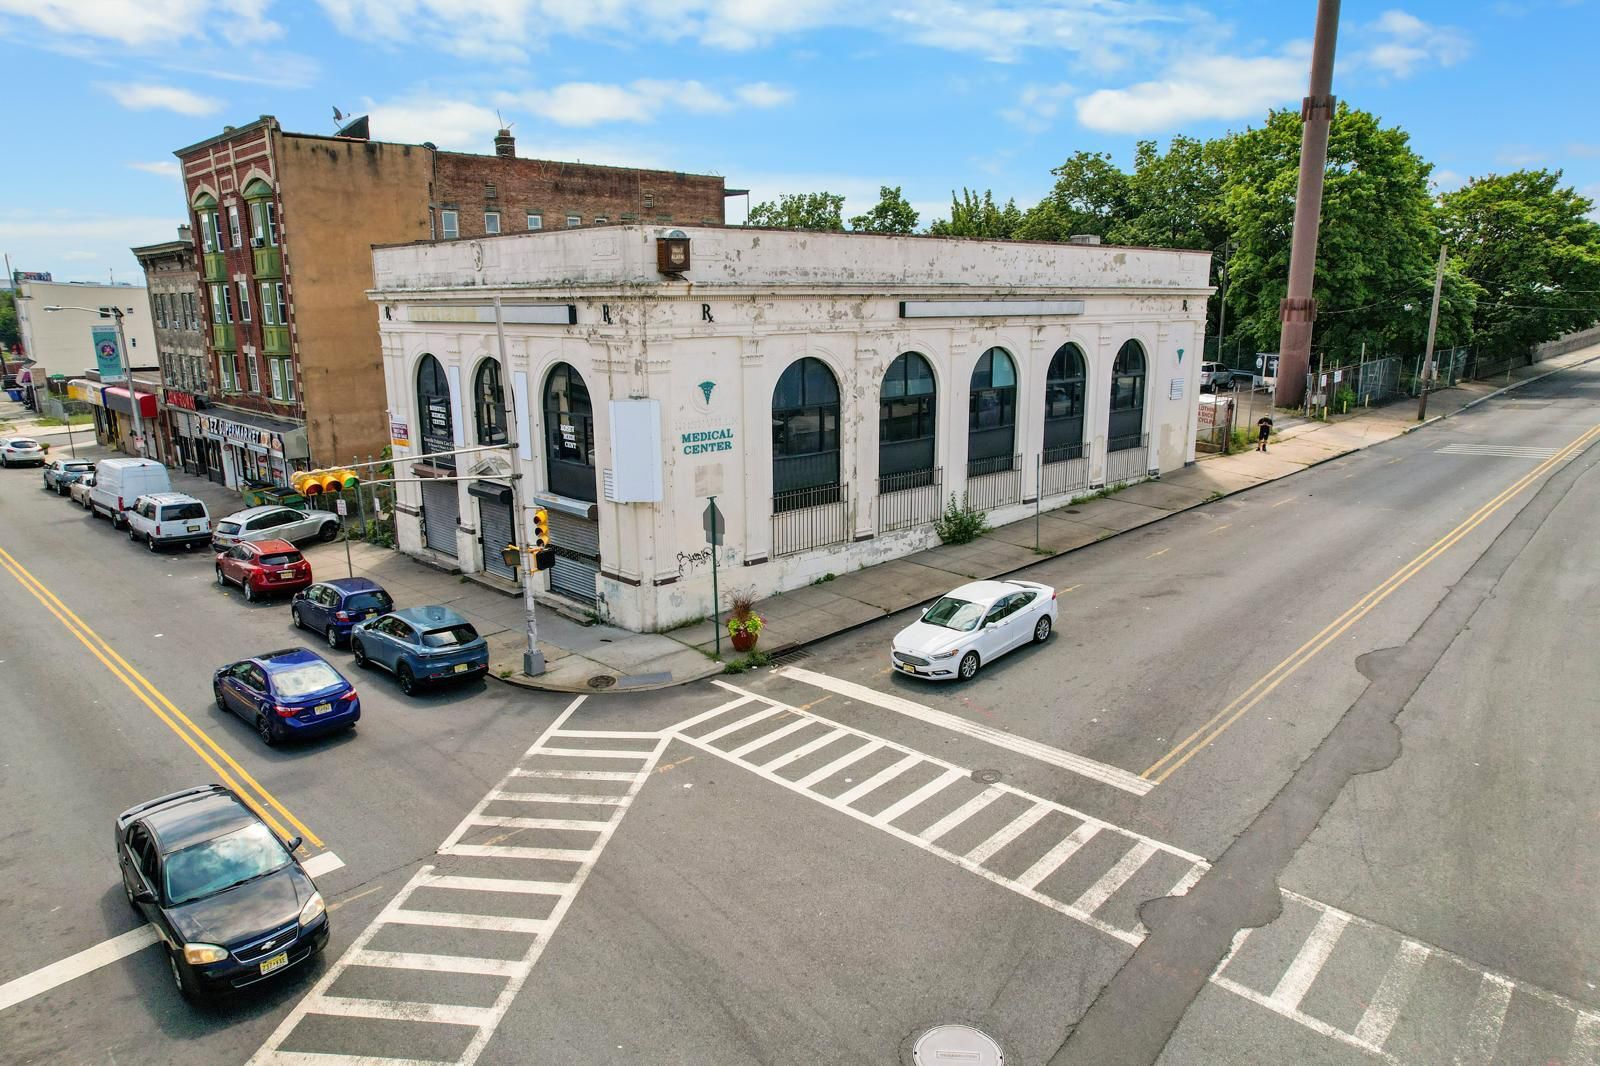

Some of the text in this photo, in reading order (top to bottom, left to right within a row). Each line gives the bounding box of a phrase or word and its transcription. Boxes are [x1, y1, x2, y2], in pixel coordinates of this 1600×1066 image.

[219, 420, 260, 444] SUPERMARKET
[681, 428, 734, 444] MEDICAL
[683, 440, 733, 455] CENTER
